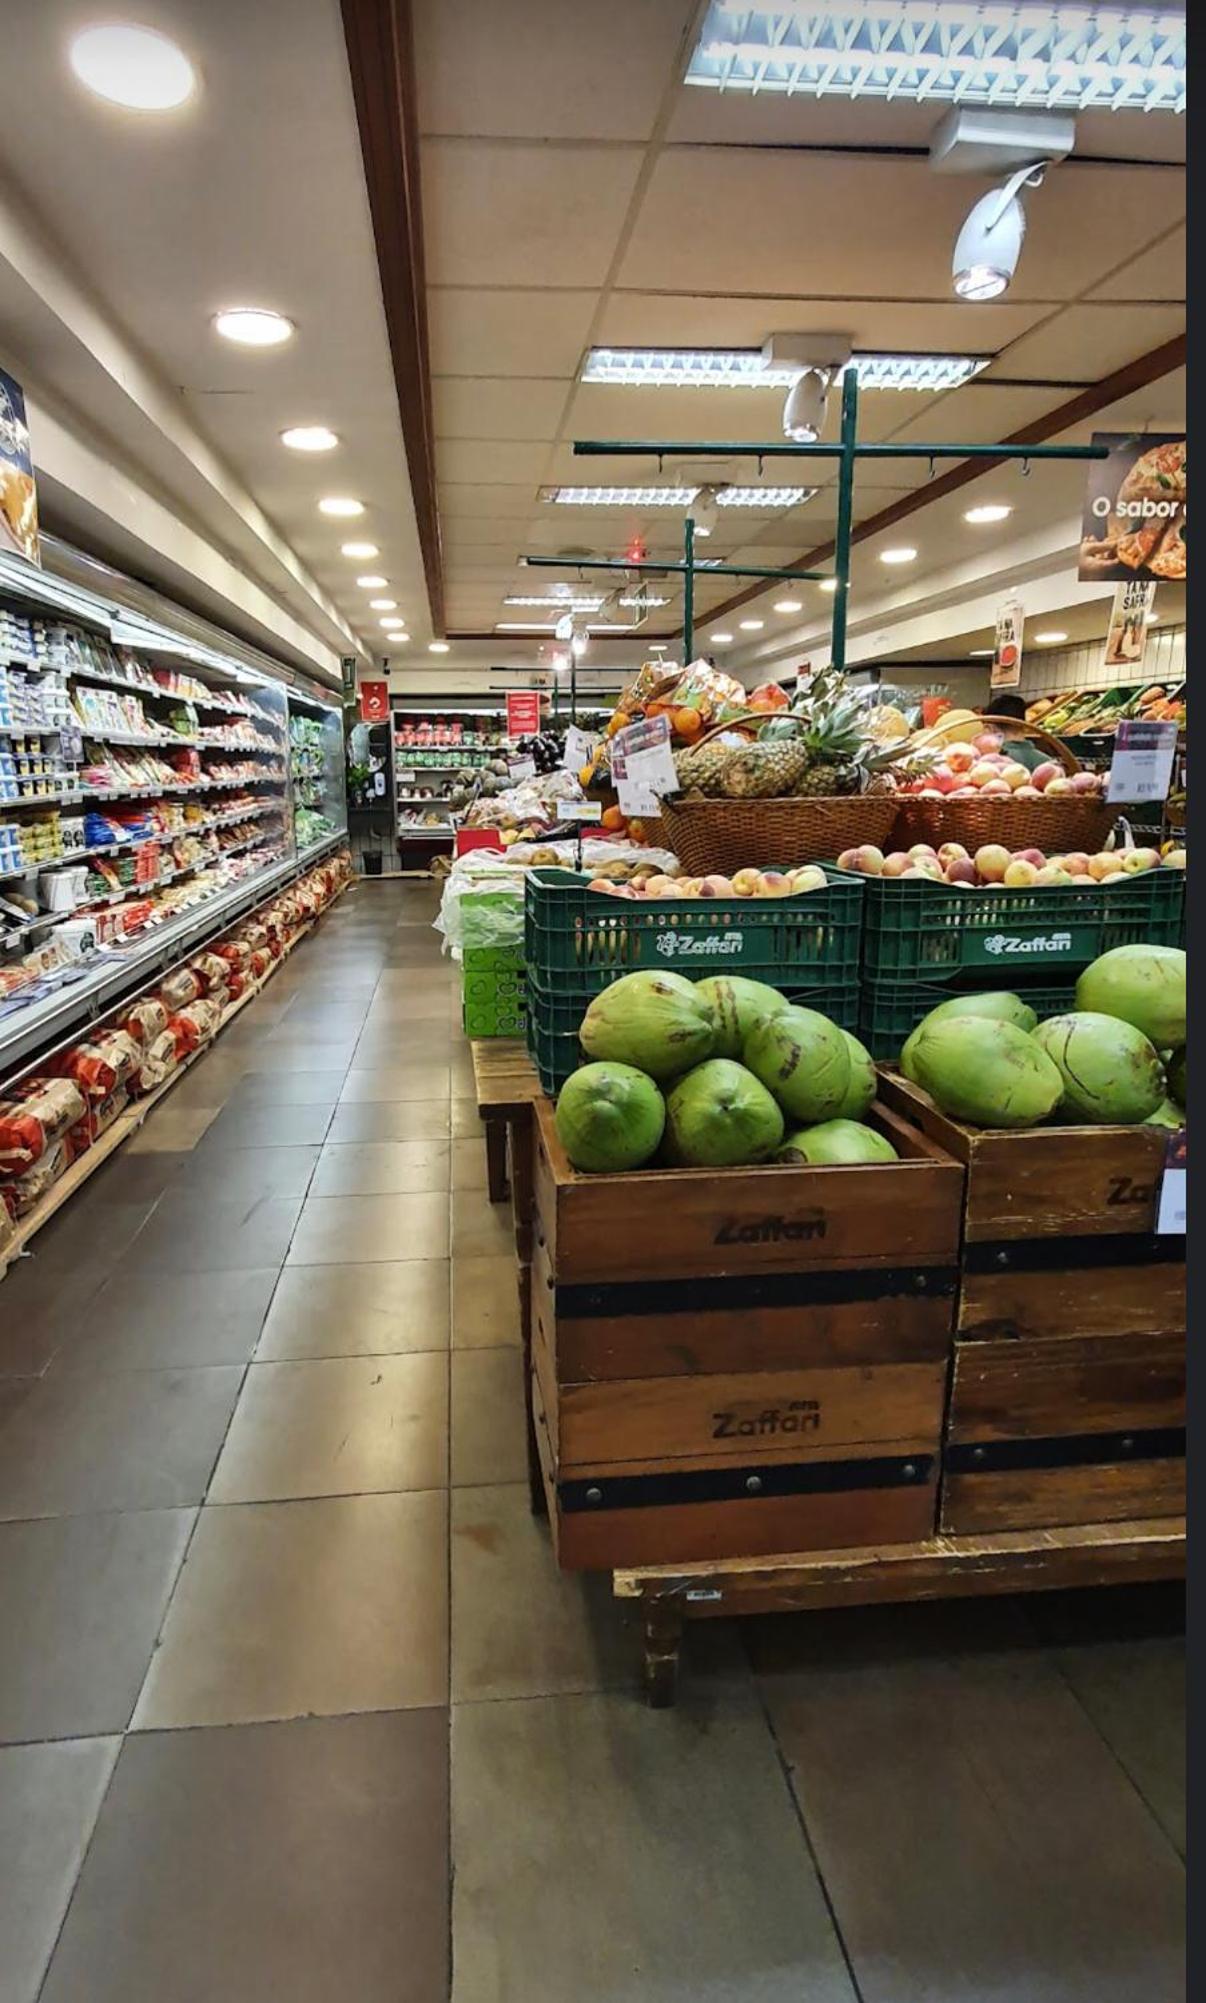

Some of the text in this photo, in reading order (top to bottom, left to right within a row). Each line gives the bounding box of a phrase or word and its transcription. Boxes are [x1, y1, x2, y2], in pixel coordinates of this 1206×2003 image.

[1092, 496, 1111, 518] O
[1116, 496, 1179, 518] sabor
[1004, 936, 1071, 953] Zaffari
[712, 1409, 820, 1439] Zaffari
